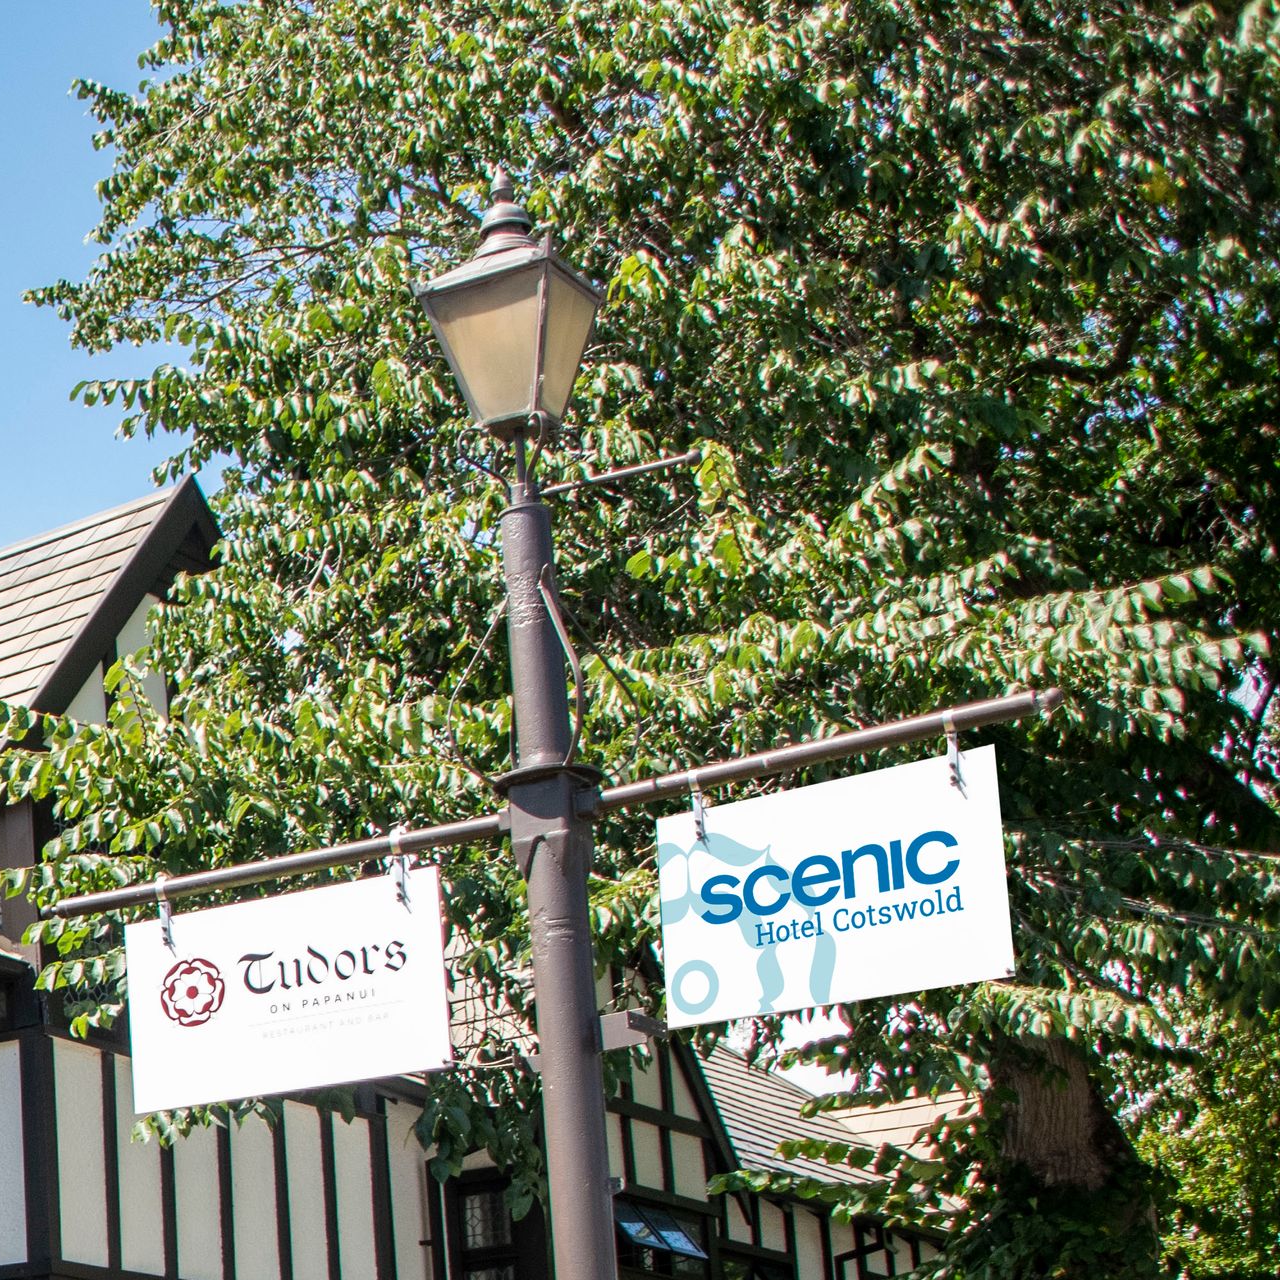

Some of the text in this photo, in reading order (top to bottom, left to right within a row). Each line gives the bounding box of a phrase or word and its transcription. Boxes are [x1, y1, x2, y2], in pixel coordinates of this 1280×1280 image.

[700, 830, 960, 925] scenic
[755, 886, 964, 947] Hotel Cotswold
[237, 939, 408, 995] Tudors
[262, 1011, 391, 1040] RESTAURANT AND BAR
[269, 987, 376, 1015] ON PAPANUI
